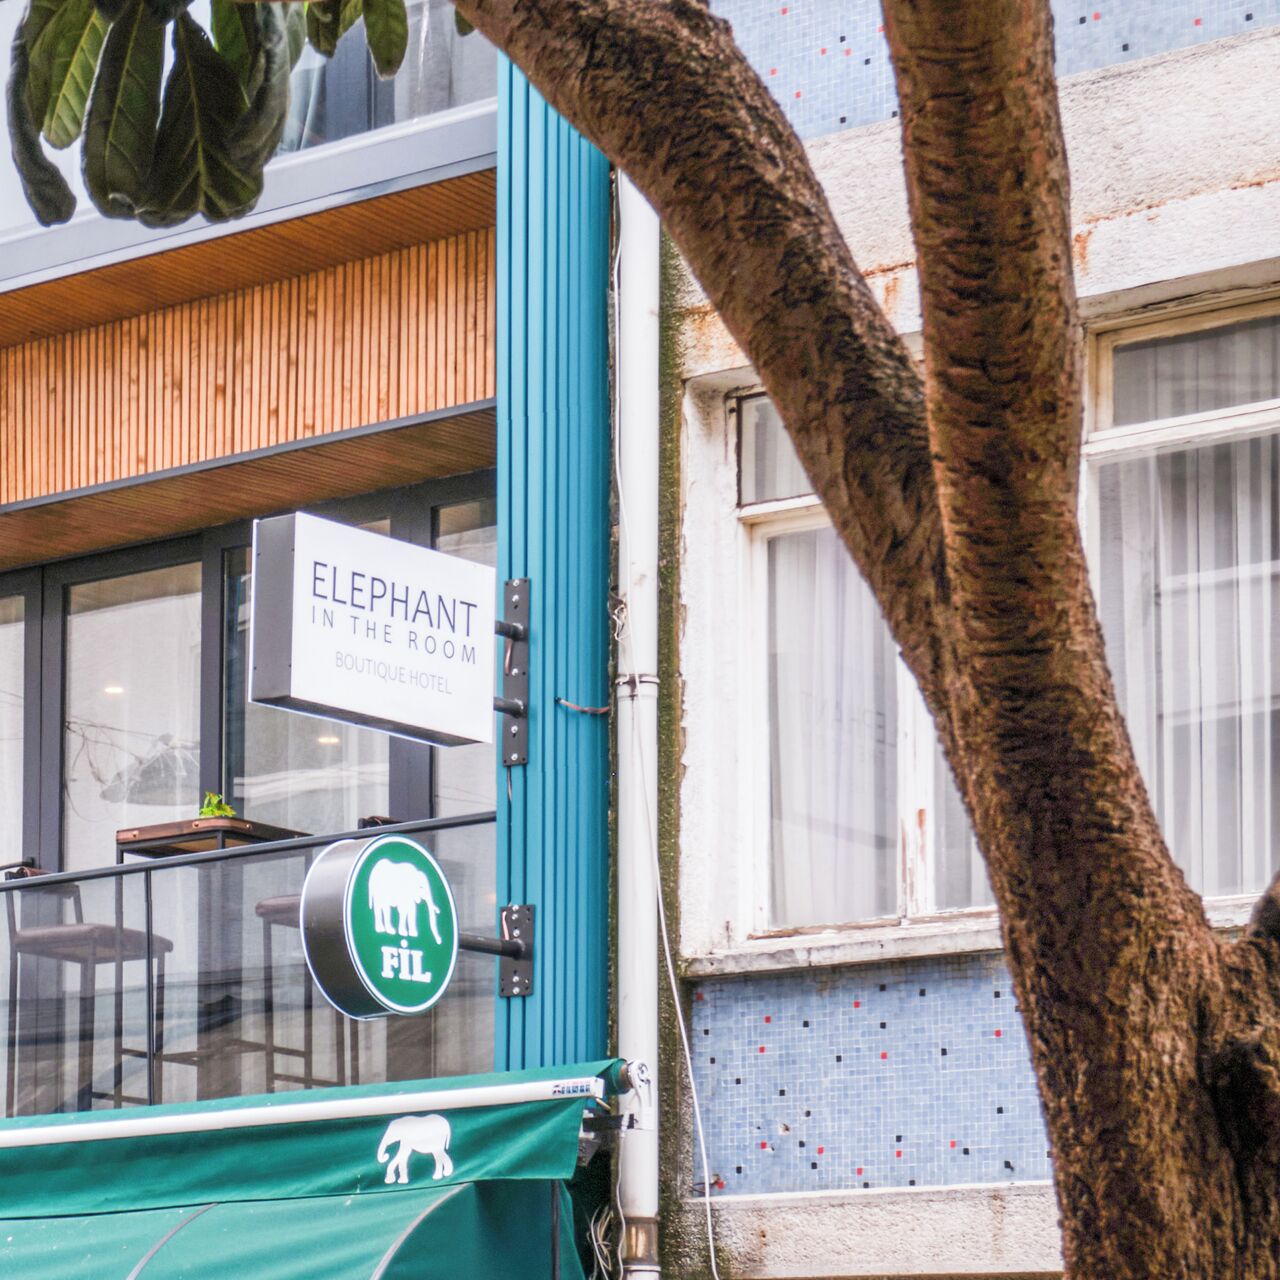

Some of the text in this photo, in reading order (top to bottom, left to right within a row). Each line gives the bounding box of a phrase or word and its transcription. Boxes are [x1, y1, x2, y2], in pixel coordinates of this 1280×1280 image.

[312, 560, 478, 638] ELEPHANT
[311, 604, 477, 665] IN THE ROOM
[334, 650, 454, 696] BOUTIQUE HOTEL
